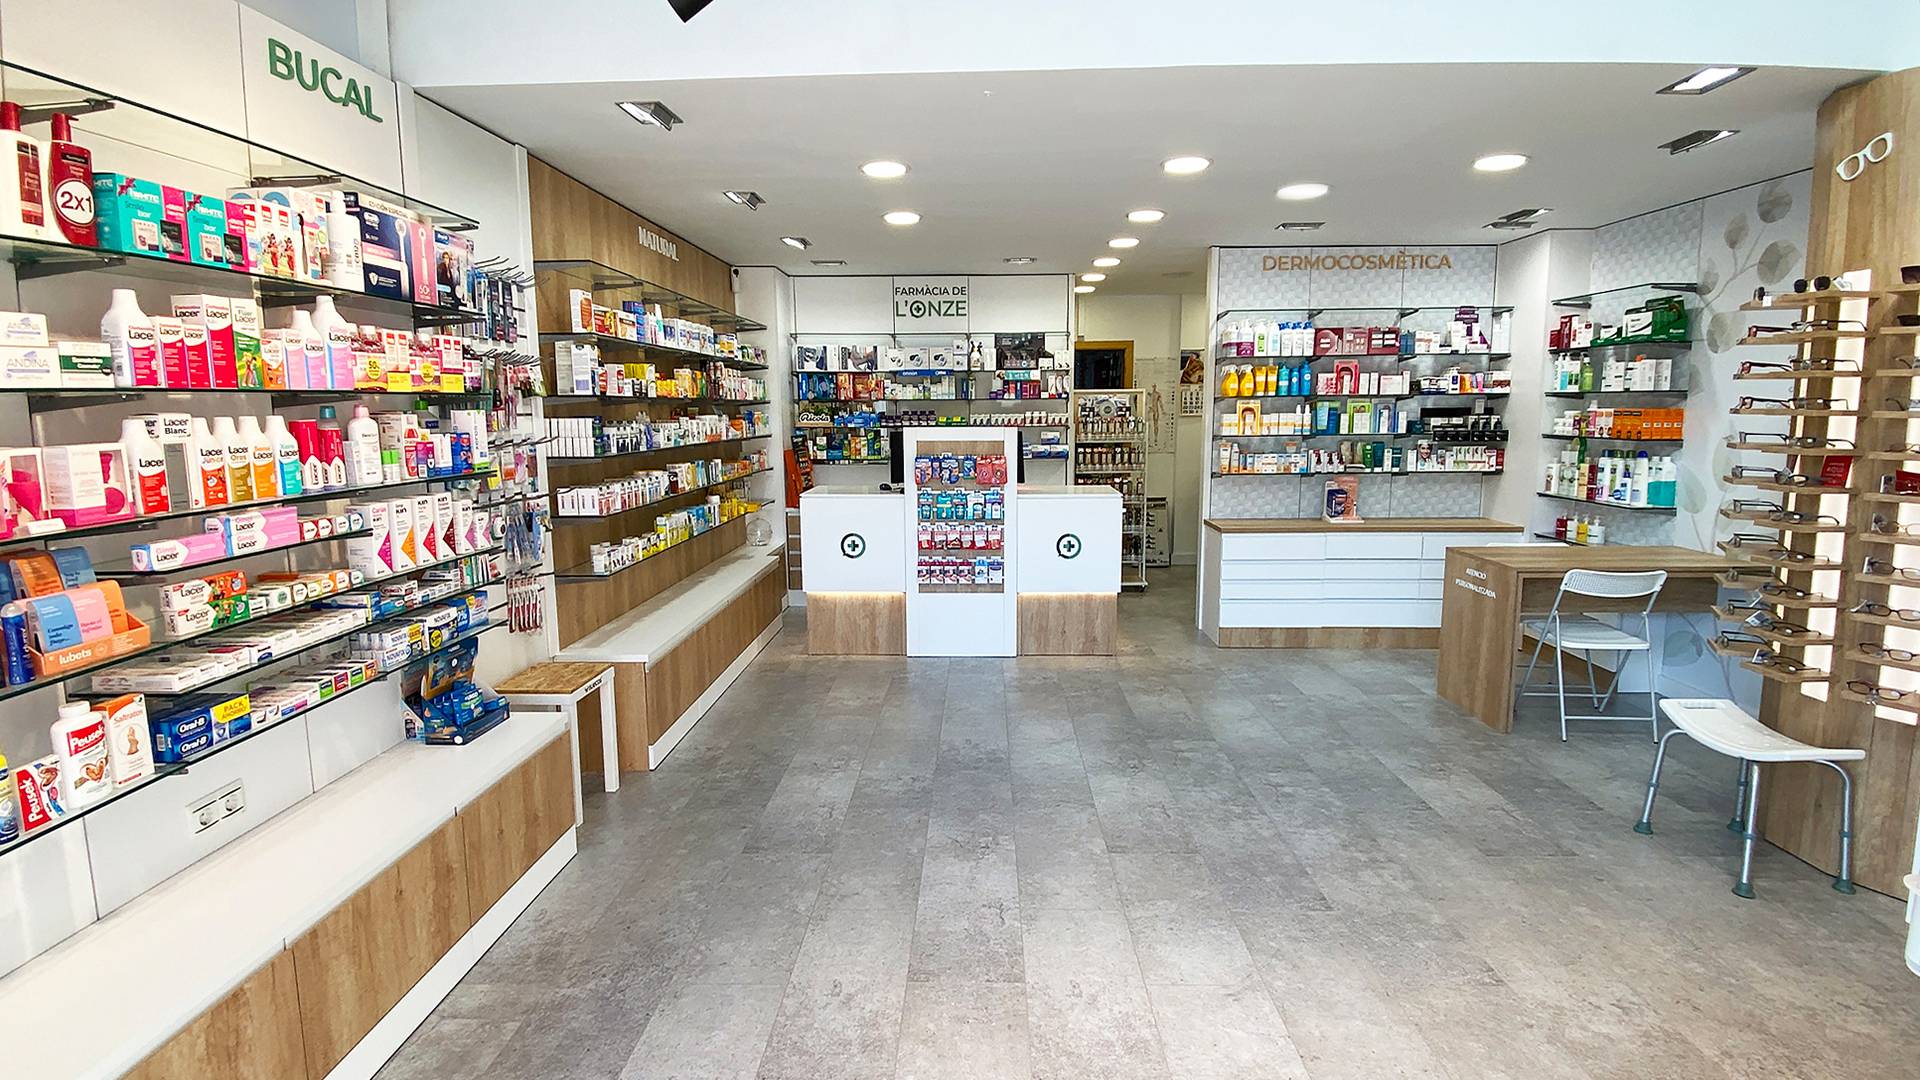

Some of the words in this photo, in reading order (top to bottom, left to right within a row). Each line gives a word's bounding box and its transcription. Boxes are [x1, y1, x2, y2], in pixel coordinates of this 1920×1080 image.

[267, 37, 384, 124] BUCAL
[60, 190, 93, 214] 2x1
[638, 225, 680, 262] NATURAL
[1262, 250, 1452, 272] DERMOCOSMÈTICA
[895, 283, 950, 296] FARMÀCIA
[952, 286, 967, 296] DE
[175, 308, 200, 318] Lacer
[206, 308, 230, 320] Lacer
[895, 300, 967, 318] L'ONZE
[235, 314, 257, 324] Lacer
[128, 330, 154, 341] Lace
[160, 327, 180, 336] Lacer
[184, 331, 204, 340] Lacer
[7, 358, 50, 368] ANDINA
[164, 418, 189, 427] Lacer
[800, 412, 830, 423] Ricola
[165, 427, 187, 435] Blanc
[200, 448, 223, 457] Lacer
[228, 446, 249, 454] Lacer
[279, 449, 298, 458] Lacer
[253, 452, 273, 460] Lacer
[139, 458, 165, 468] Lacer
[236, 522, 255, 531] Lacer
[237, 540, 257, 550] Lacer
[156, 552, 180, 562] Lacer
[180, 585, 205, 598] Lacer
[185, 609, 209, 622] Lacer
[58, 648, 93, 665] lubets
[223, 701, 244, 713] PACK
[179, 716, 206, 733] Oral-B
[70, 723, 105, 752] Peusek
[181, 735, 208, 753] Oral-B
[20, 777, 45, 823] Peusek
